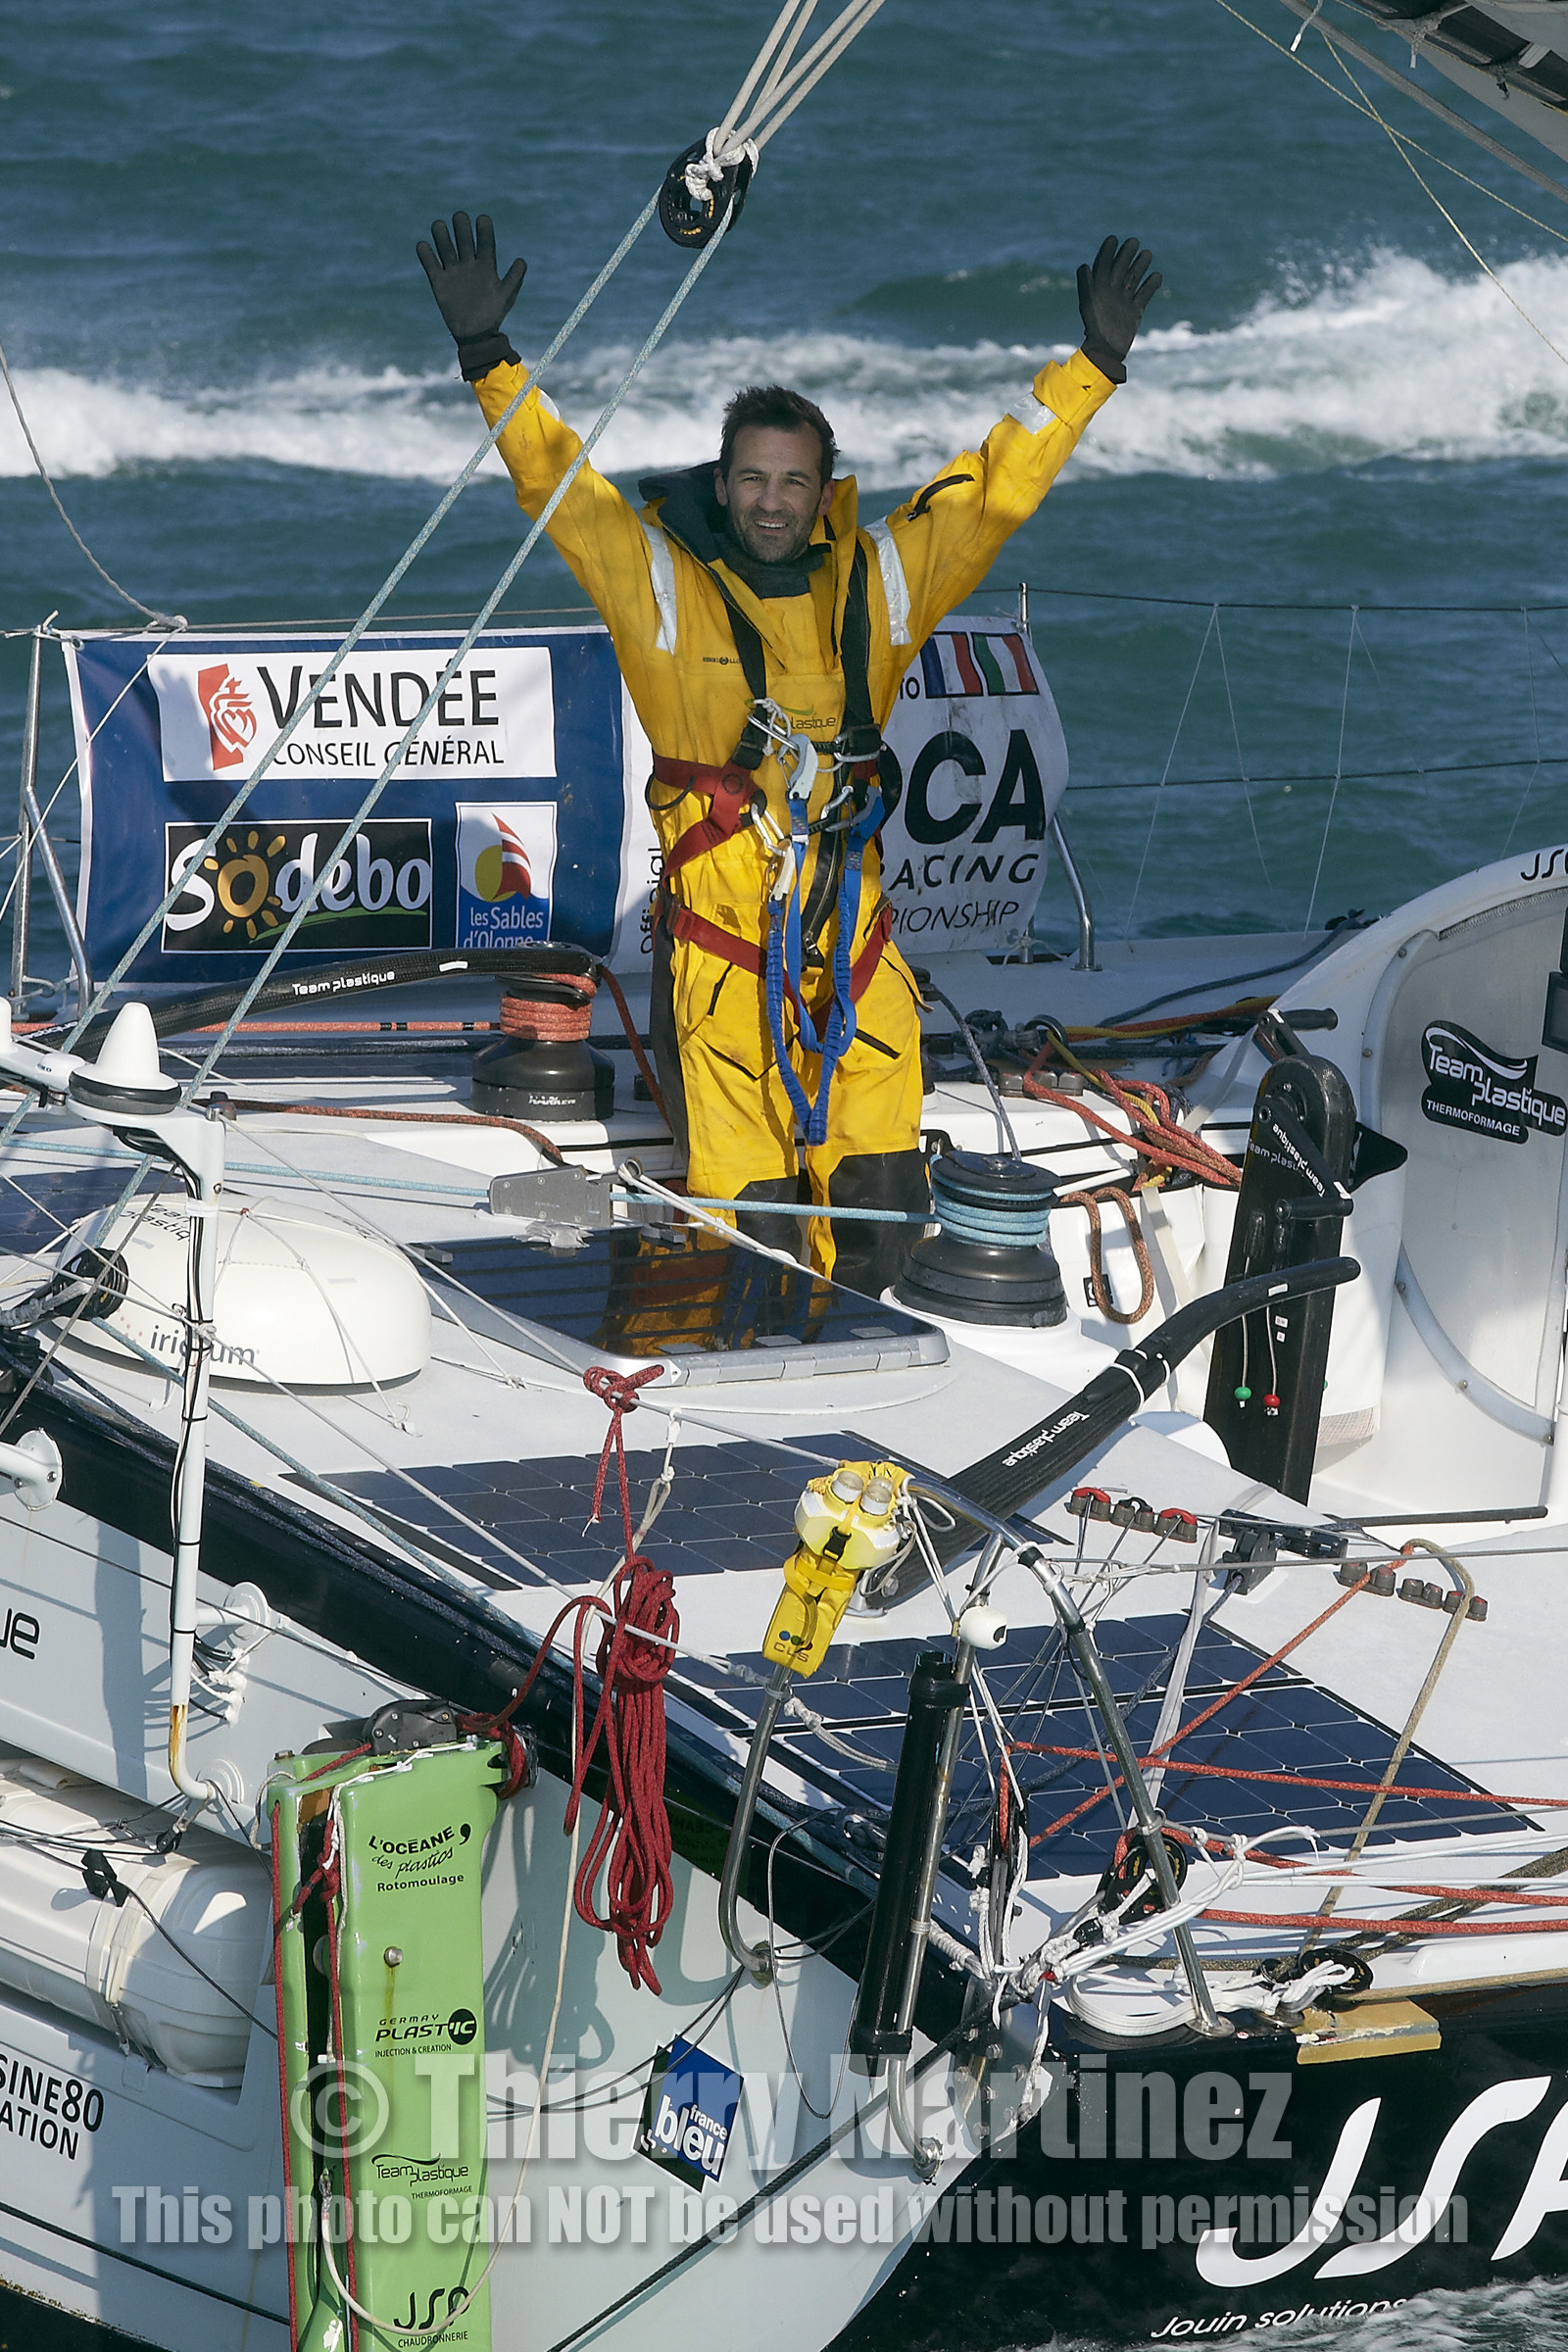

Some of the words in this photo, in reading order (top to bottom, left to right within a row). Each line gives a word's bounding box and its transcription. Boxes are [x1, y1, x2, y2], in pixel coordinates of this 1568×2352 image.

[257, 658, 499, 729] VENDÉE
[880, 854, 1039, 891] ACING
[1520, 848, 1568, 881] JS
[166, 832, 431, 931] Sodebo
[640, 848, 664, 955] Offcial
[470, 906, 488, 926] les
[491, 905, 544, 929] Sables
[292, 982, 330, 996] Team
[332, 970, 395, 993] plastique
[1429, 1045, 1484, 1083] Team
[1471, 1077, 1566, 1127] plastique
[1426, 1099, 1521, 1137] THERMOFORMAGE
[150, 1325, 255, 1366] irium
[371, 1855, 393, 1870] des
[377, 1875, 465, 1892] Rotomoulage
[379, 2014, 439, 2026] GERMAY
[374, 2047, 411, 2058] INJECTION
[412, 2046, 417, 2055] &
[417, 2043, 452, 2054] CREATION
[654, 2094, 725, 2176] bleu
[690, 2104, 728, 2140] france
[376, 2164, 414, 2179] Team
[410, 2164, 468, 2186] plastique
[412, 2185, 472, 2200] THERMOFORMAGE
[398, 2330, 468, 2348] CHAUDRONNERIE
[1151, 2311, 1248, 2339] Jouin
